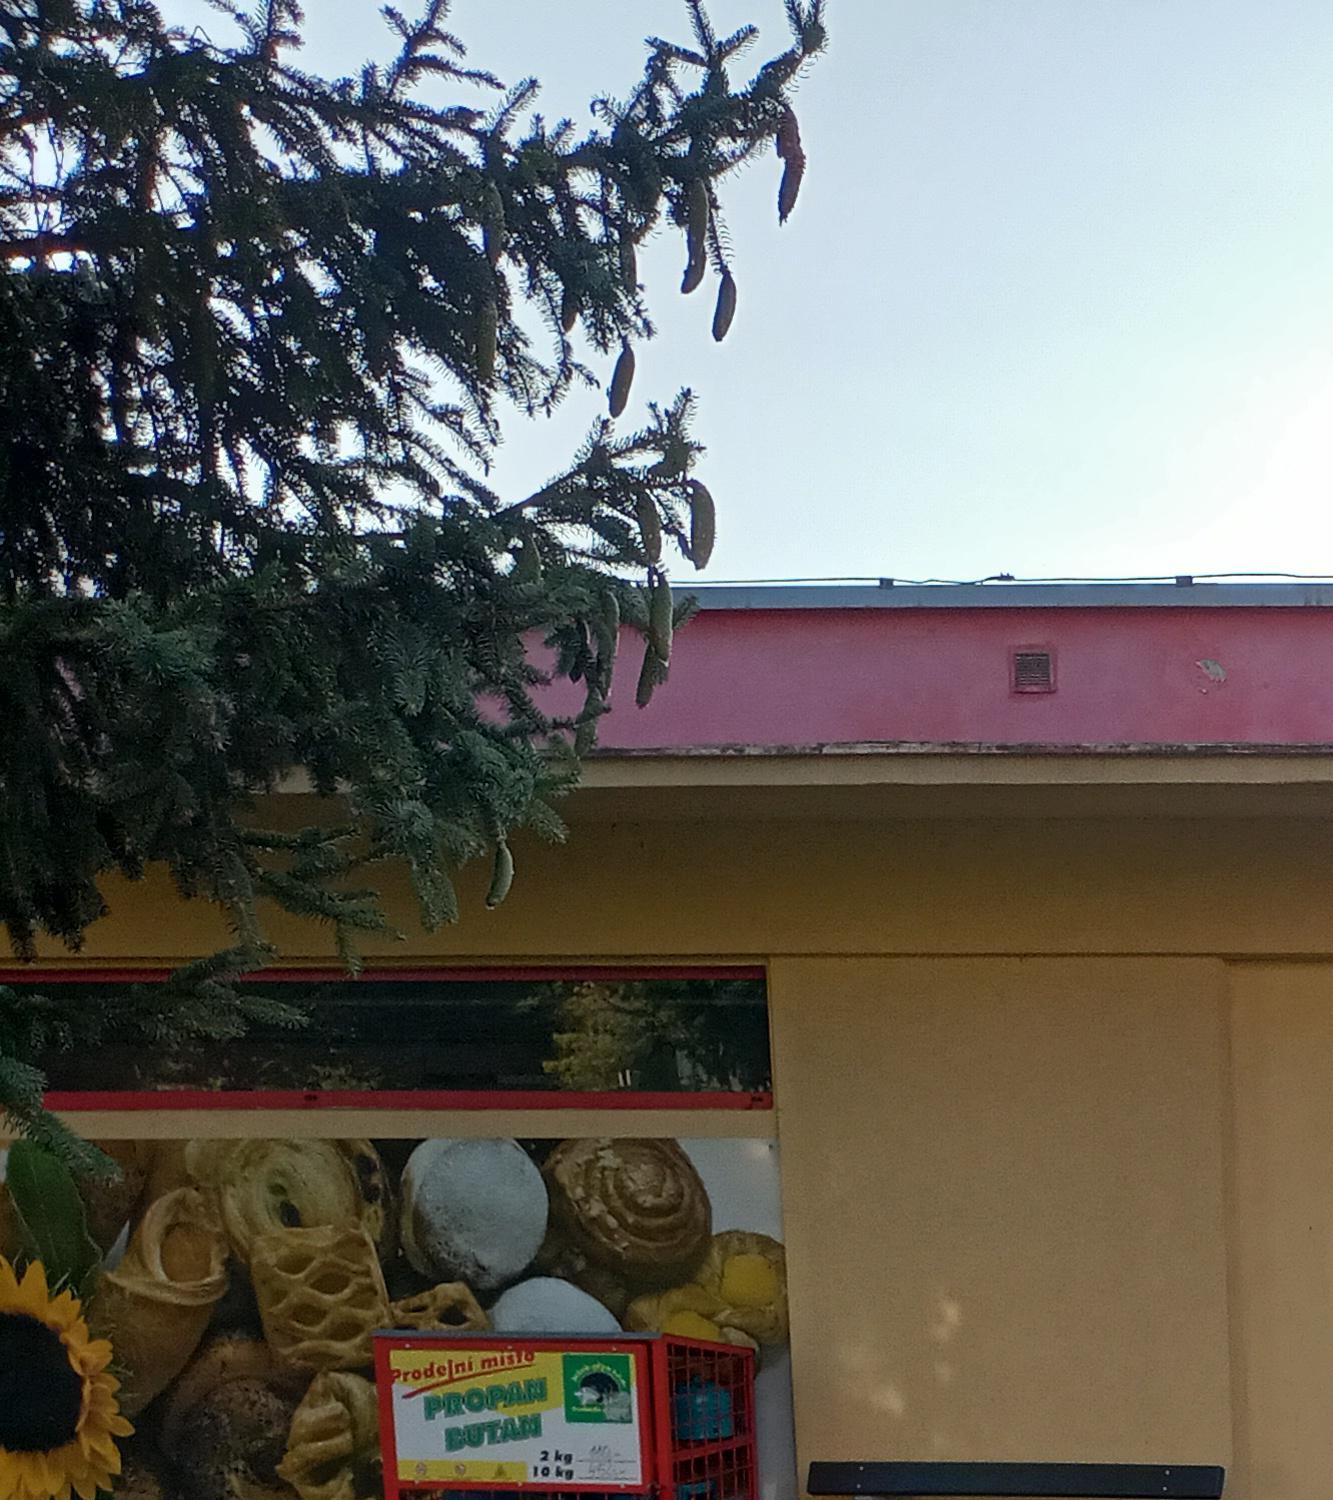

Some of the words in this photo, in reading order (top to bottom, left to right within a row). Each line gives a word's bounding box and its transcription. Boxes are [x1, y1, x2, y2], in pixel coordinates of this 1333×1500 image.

[423, 1377, 548, 1421] PROPAN
[445, 1413, 542, 1452] BUTAN
[540, 1450, 550, 1462] 2
[554, 1449, 573, 1465] kg
[533, 1466, 550, 1478] 10
[555, 1464, 575, 1480] kg
